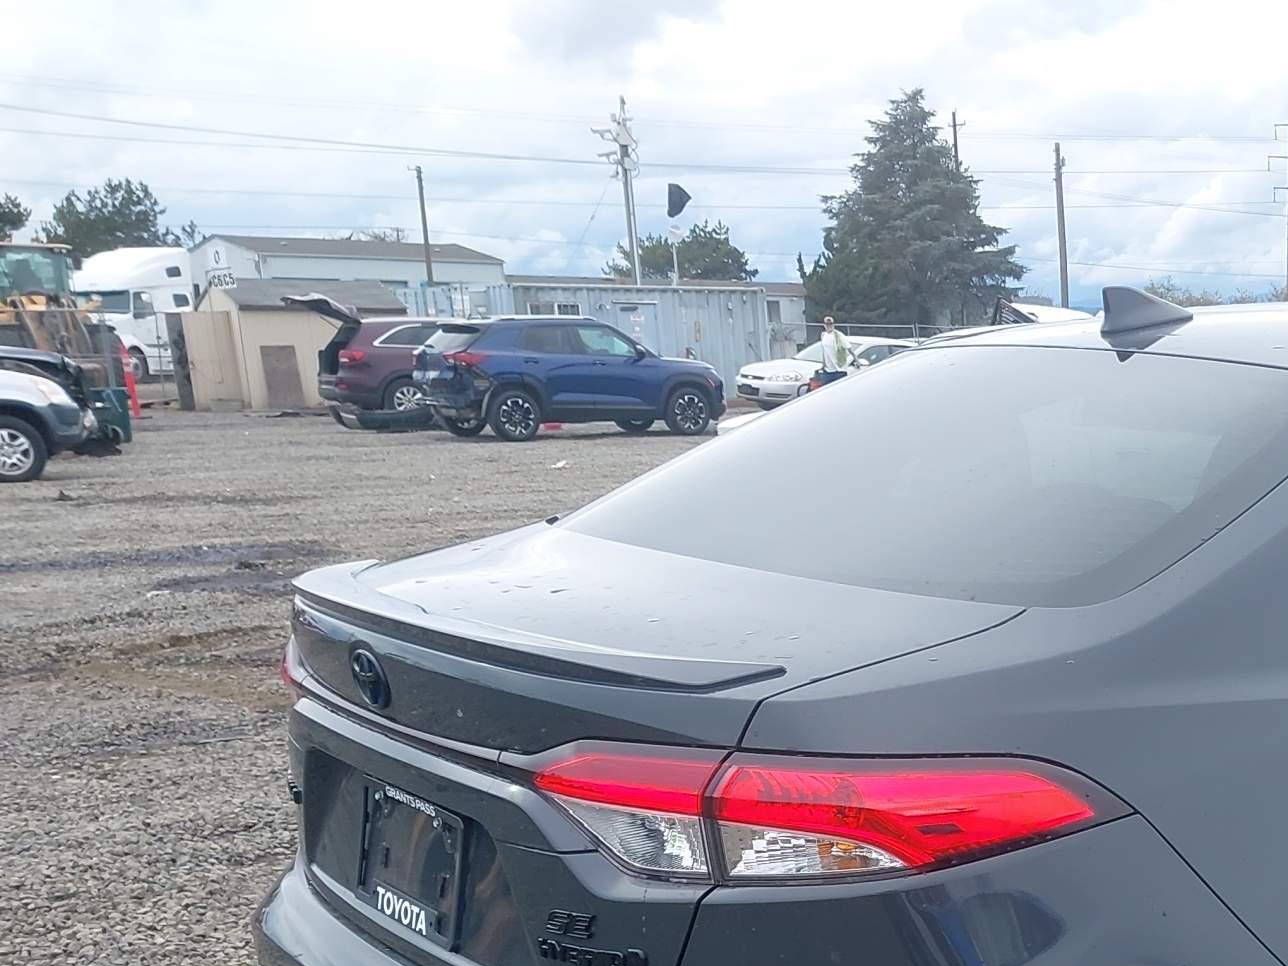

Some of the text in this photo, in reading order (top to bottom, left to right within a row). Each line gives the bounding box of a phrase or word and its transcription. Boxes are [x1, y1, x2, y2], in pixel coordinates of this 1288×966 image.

[385, 785, 436, 817] GRANTS PASS
[376, 886, 427, 936] TOYOTA
[545, 908, 596, 939] SE
